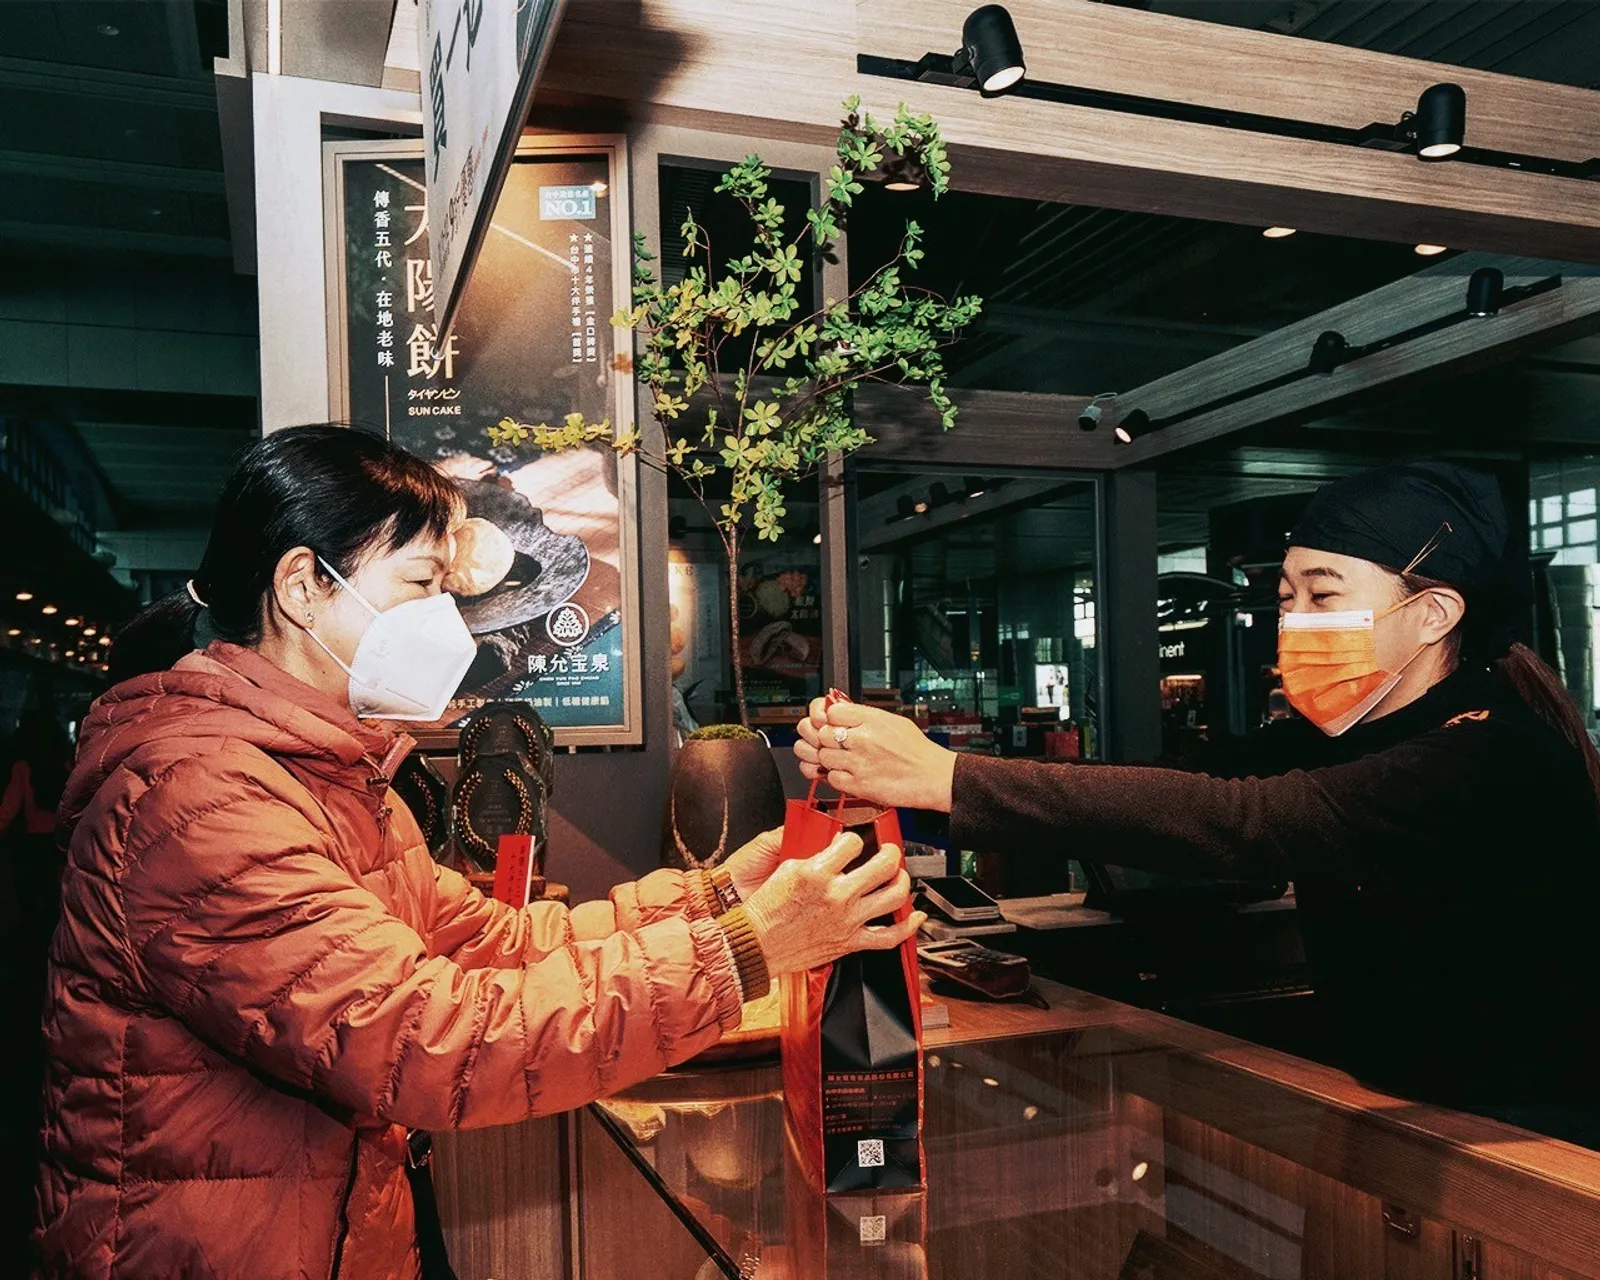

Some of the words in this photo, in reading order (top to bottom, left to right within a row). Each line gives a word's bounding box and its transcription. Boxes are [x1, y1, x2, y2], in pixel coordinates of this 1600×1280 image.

[543, 199, 593, 217] NO.1
[408, 406, 431, 417] SUN
[432, 405, 462, 416] CAKE
[527, 653, 610, 674] 陳允宝泉
